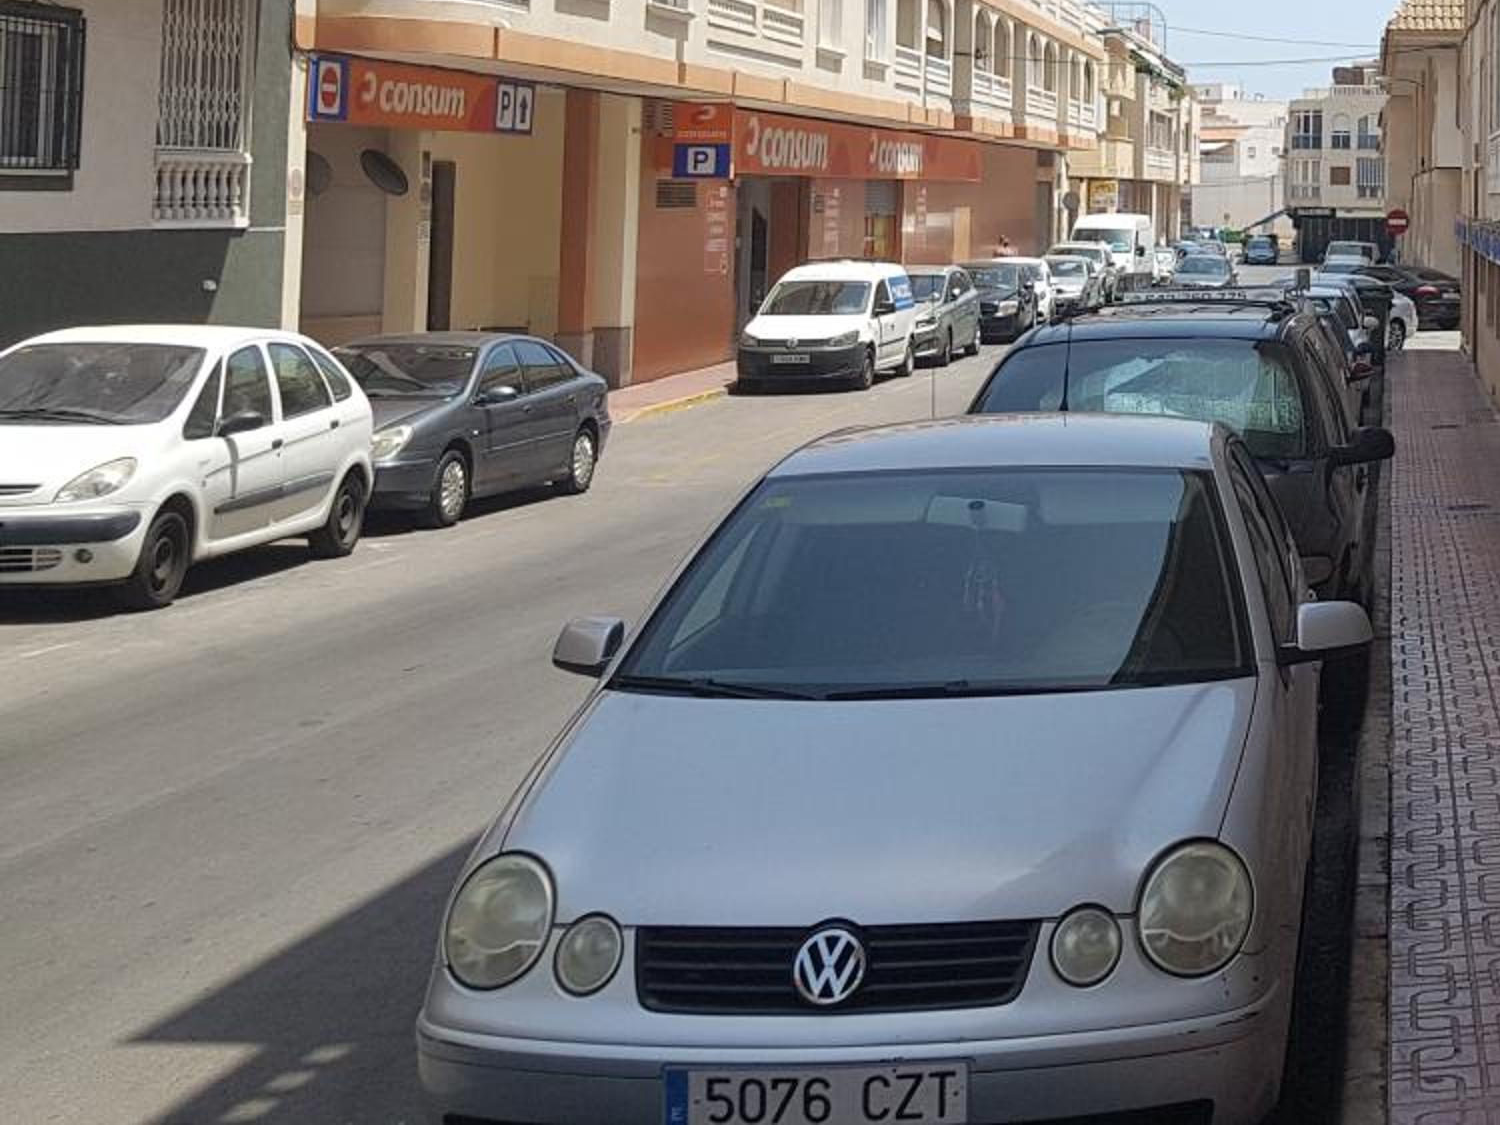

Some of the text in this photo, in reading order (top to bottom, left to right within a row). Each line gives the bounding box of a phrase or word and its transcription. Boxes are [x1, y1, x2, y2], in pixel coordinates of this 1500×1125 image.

[379, 80, 466, 120] consum
[500, 90, 511, 118] P
[693, 150, 709, 172] P
[760, 127, 829, 170] consum
[877, 139, 924, 173] consum
[706, 1070, 957, 1125] 5076 CZT
